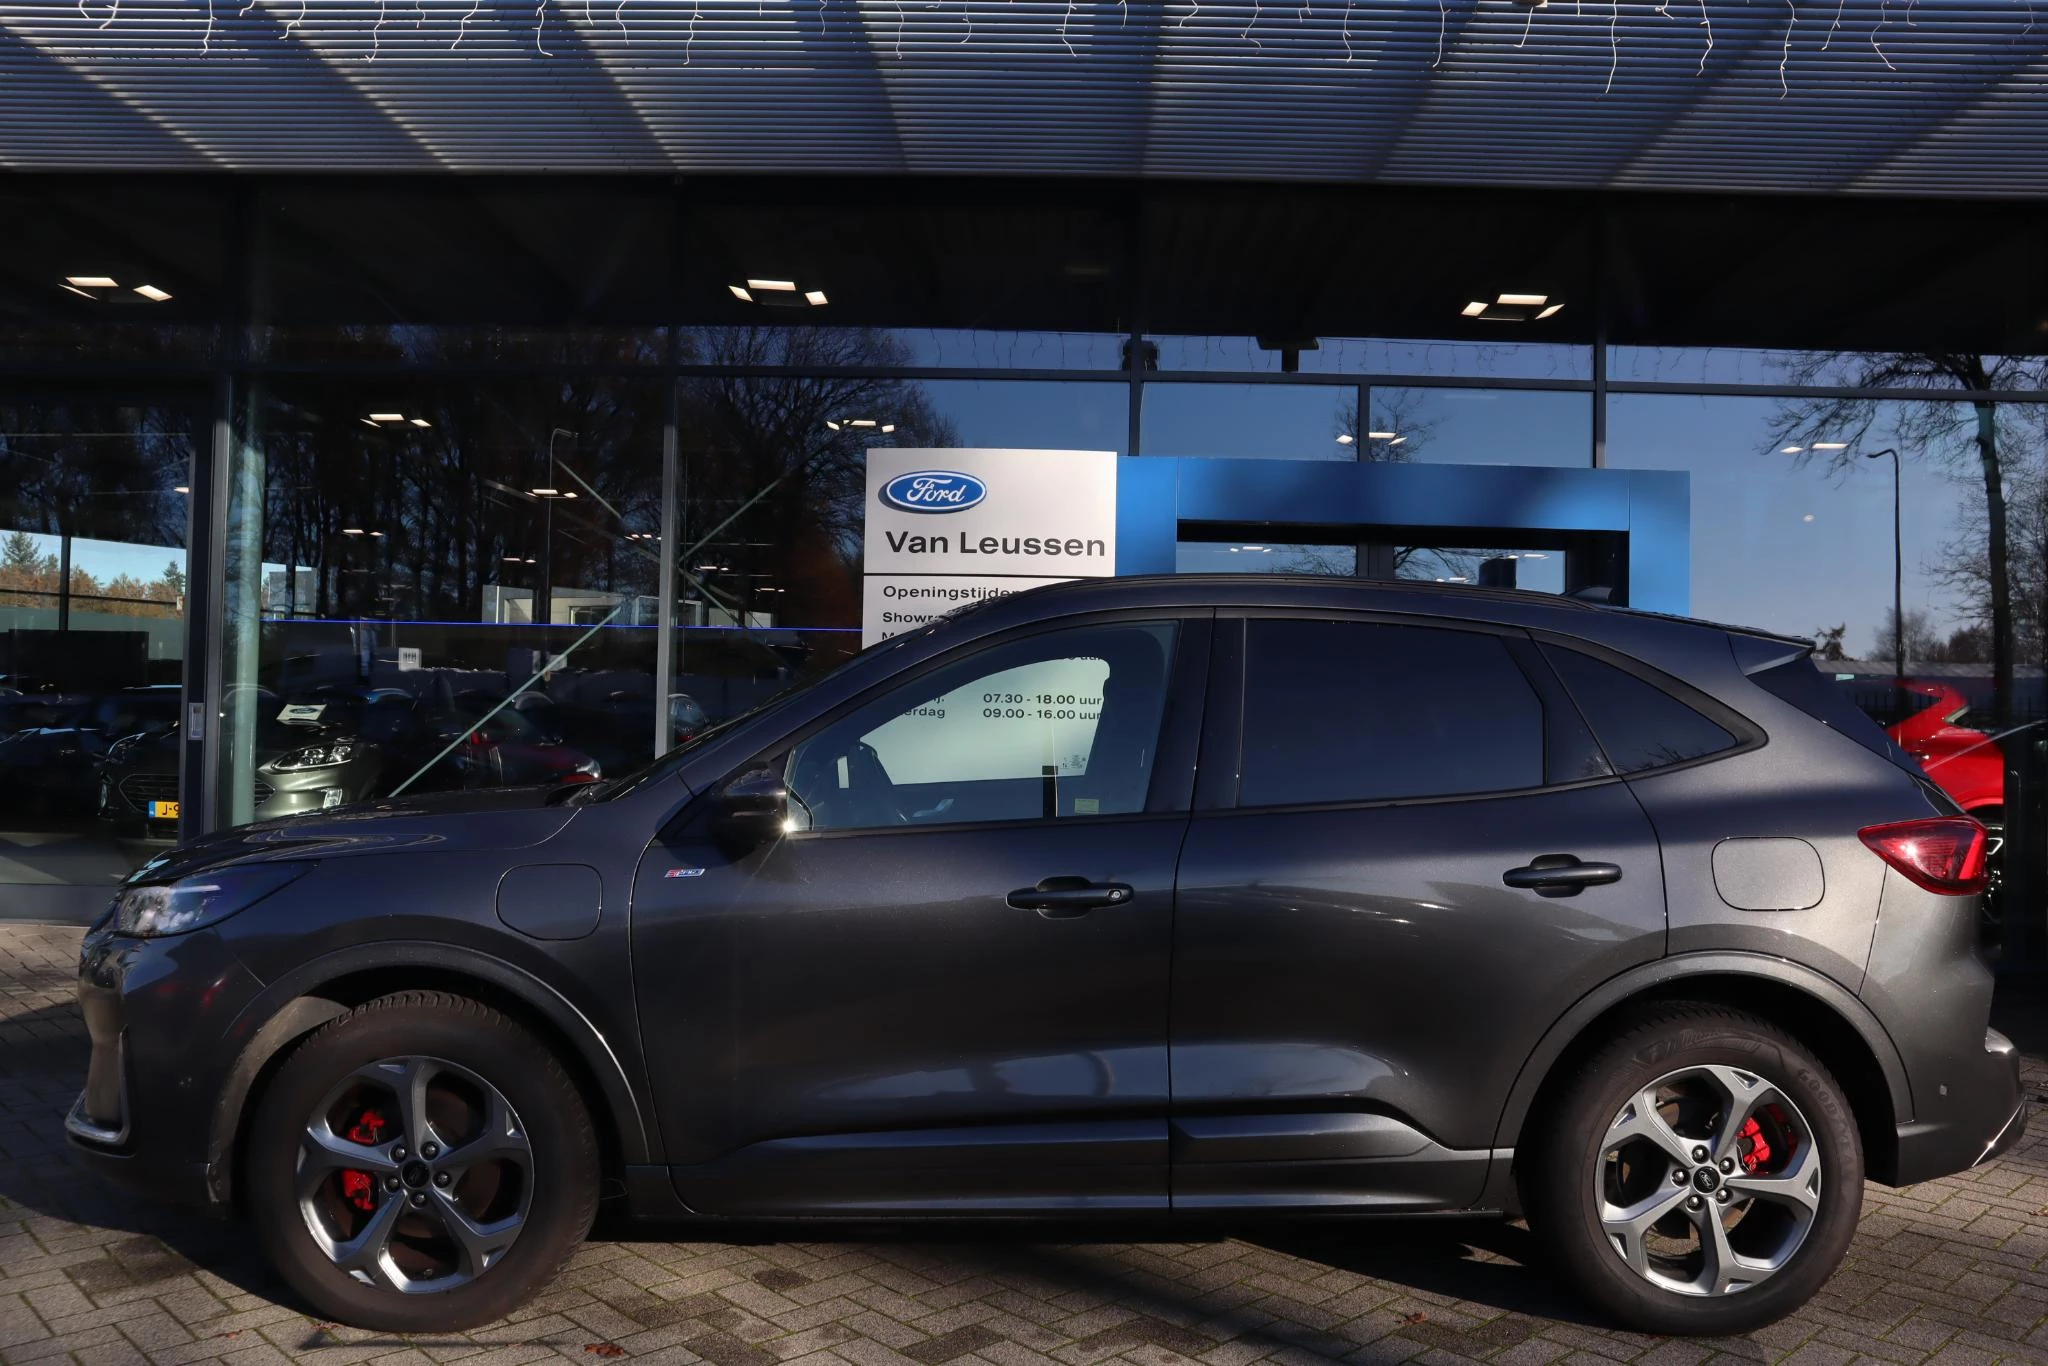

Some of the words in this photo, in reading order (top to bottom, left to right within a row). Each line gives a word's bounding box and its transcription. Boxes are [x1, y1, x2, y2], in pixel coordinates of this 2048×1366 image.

[906, 477, 967, 503] Ford
[885, 531, 949, 553] Van
[960, 531, 1105, 557] Leussen
[983, 693, 1023, 704] 07.30
[1036, 694, 1076, 705] 18.00
[1079, 697, 1102, 705] uur
[904, 707, 945, 719] erdag
[983, 708, 1025, 719] 09.00
[1036, 709, 1076, 720] 16.00
